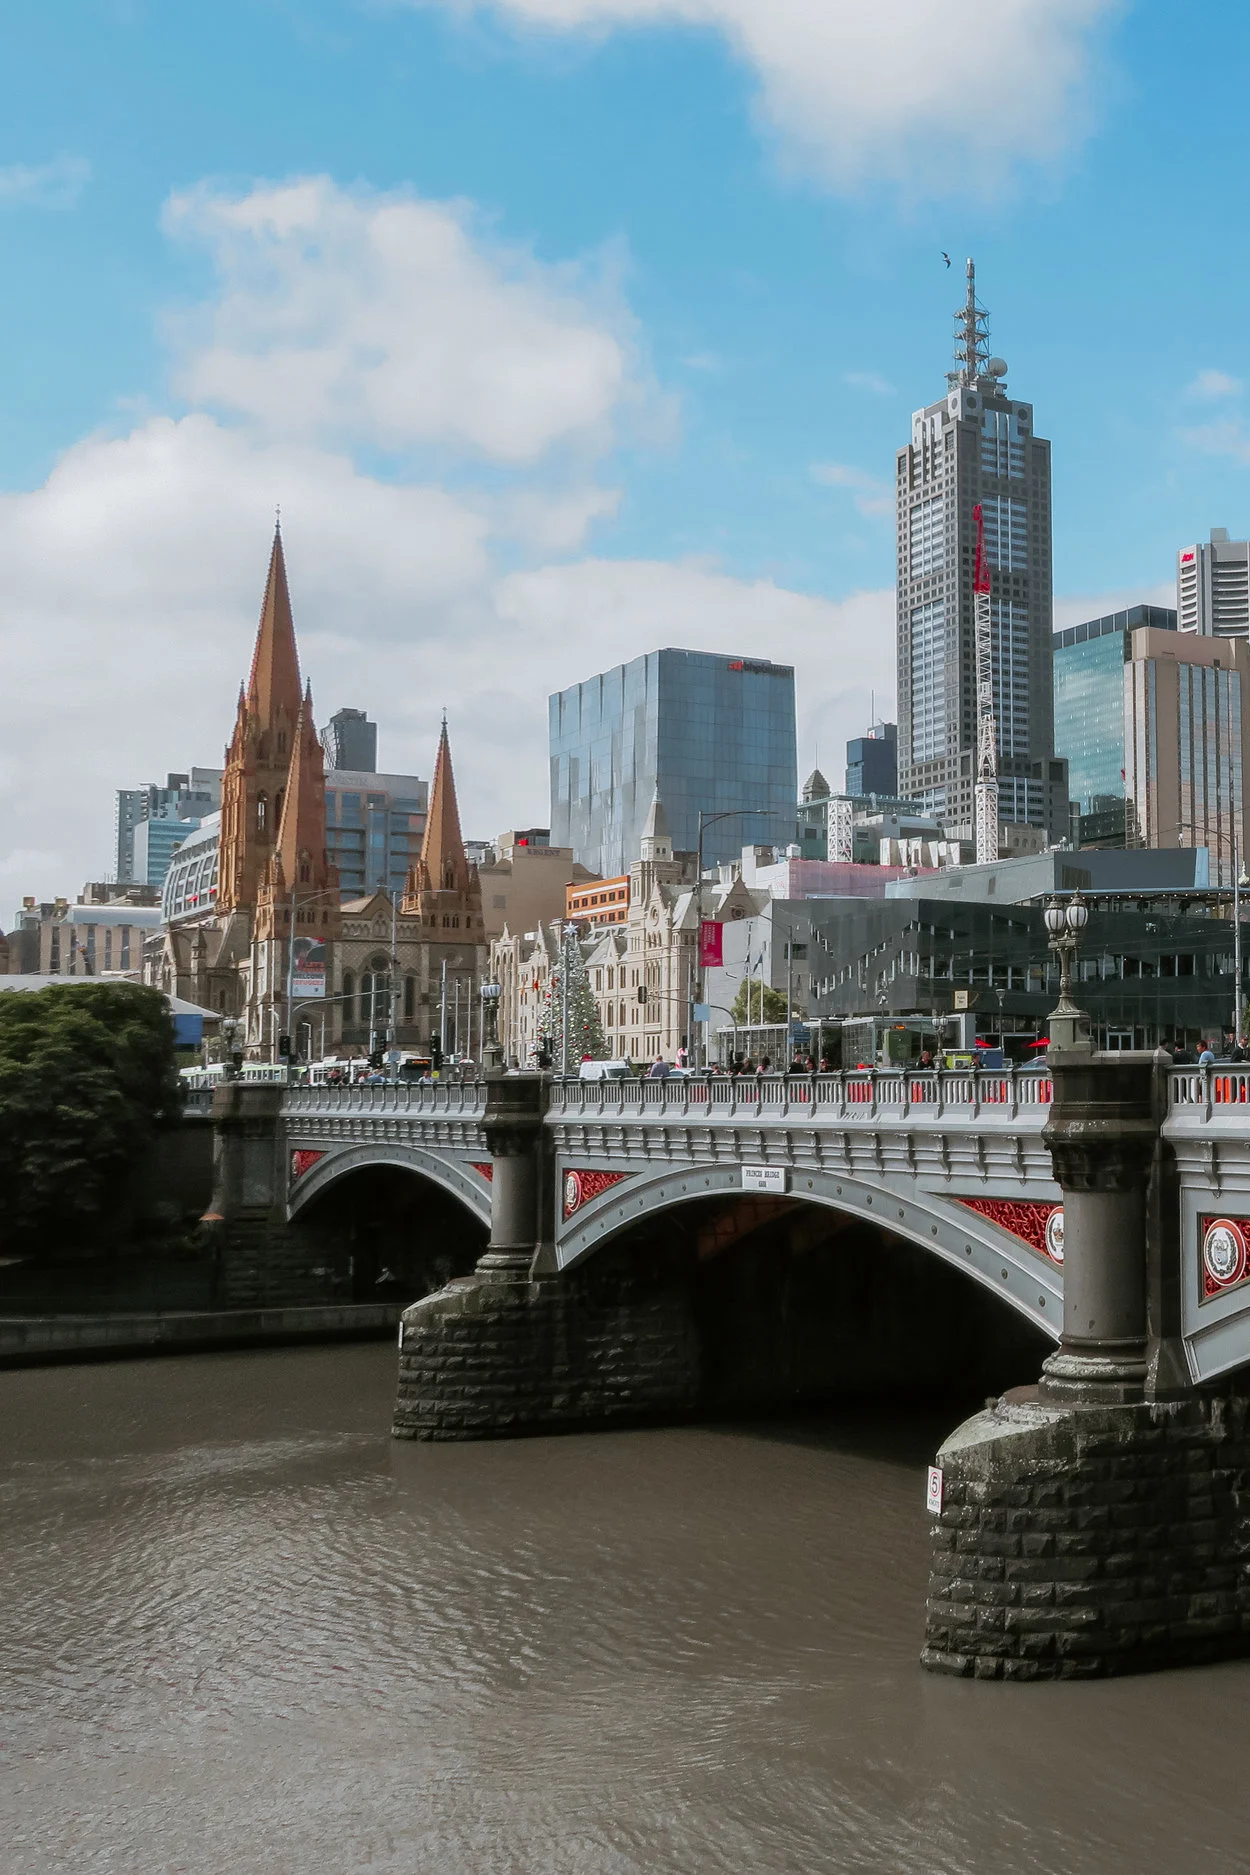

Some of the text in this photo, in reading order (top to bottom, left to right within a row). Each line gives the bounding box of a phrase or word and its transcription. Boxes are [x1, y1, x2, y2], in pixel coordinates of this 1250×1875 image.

[746, 1169, 780, 1179] PRINCES BRIDGE
[931, 1476, 938, 1494] 5
[928, 1498, 940, 1509] KNOTS
